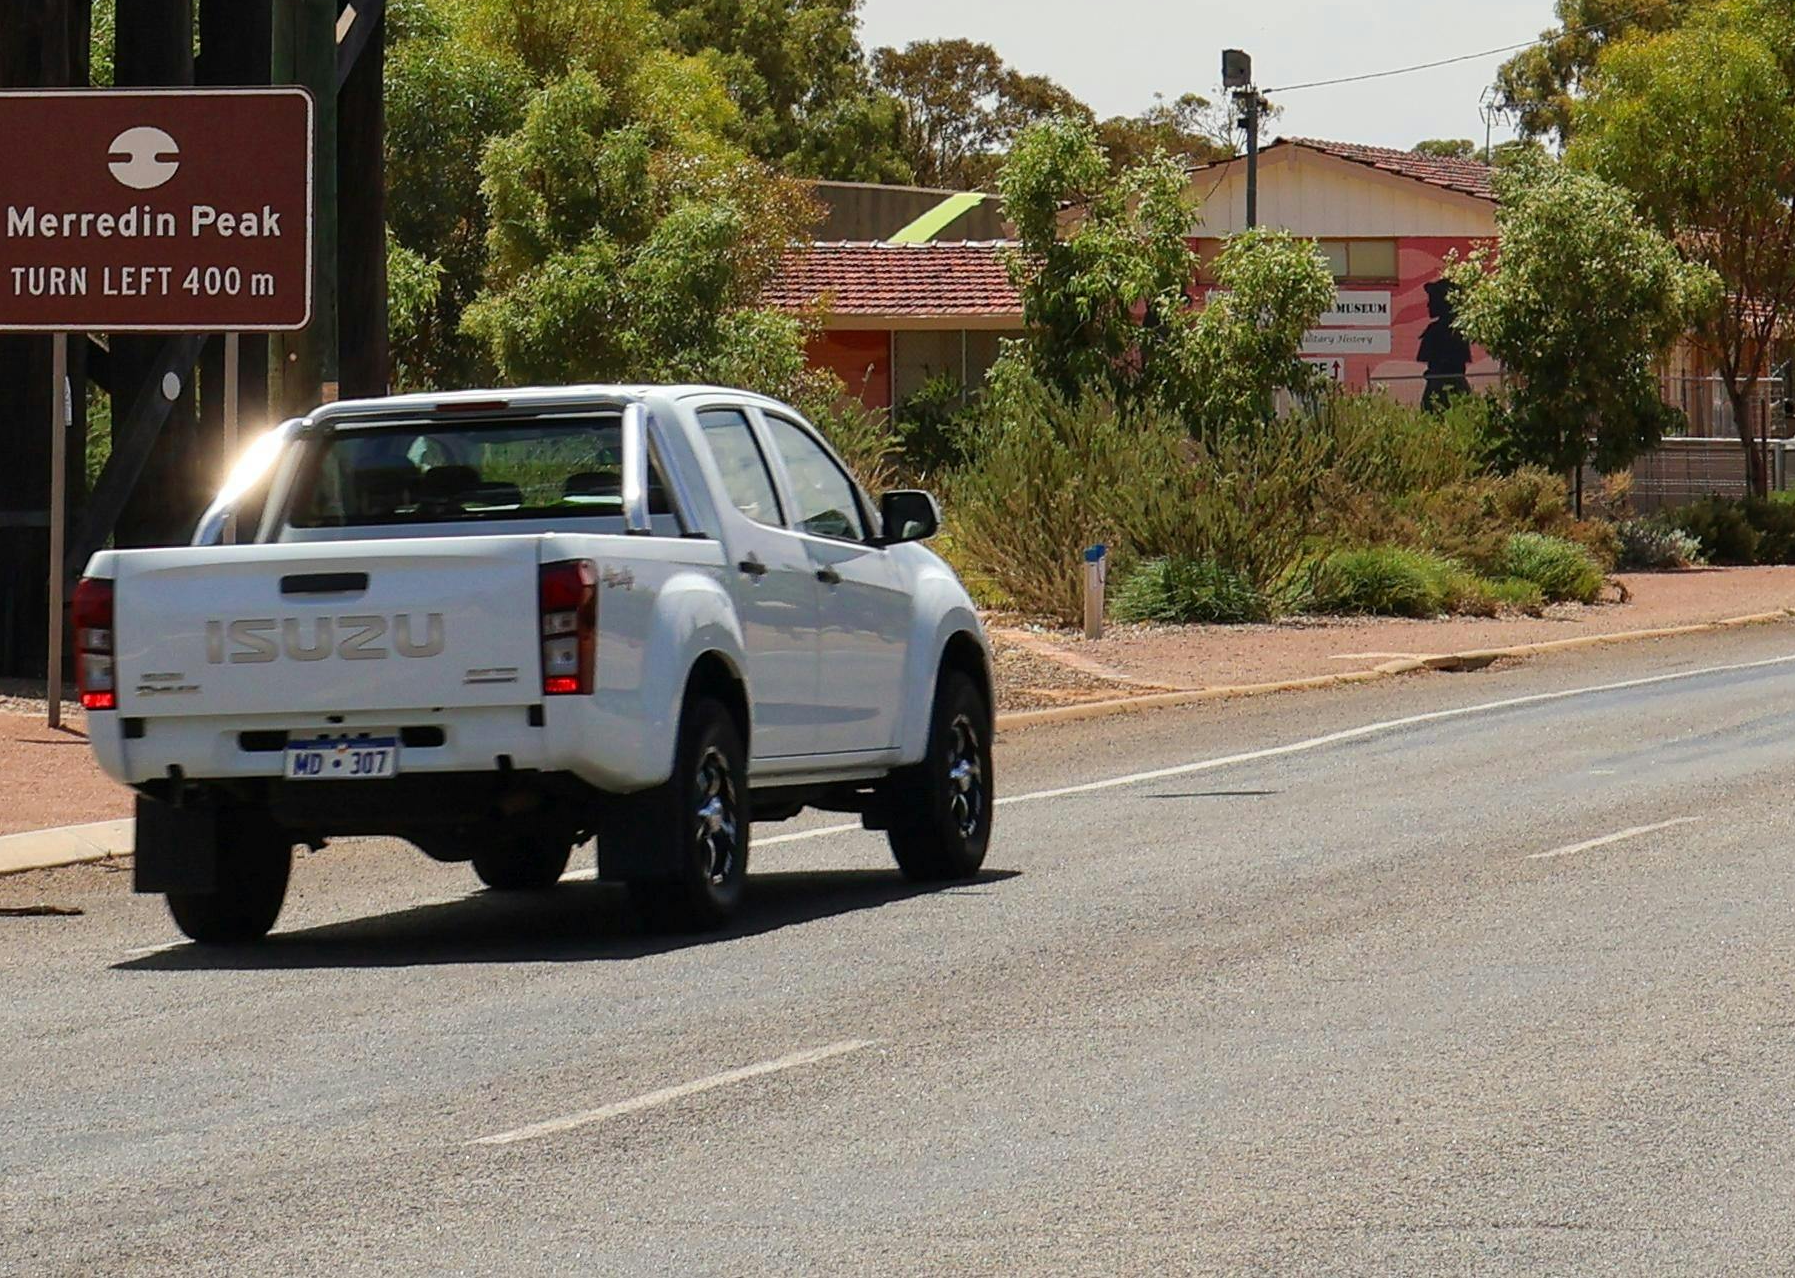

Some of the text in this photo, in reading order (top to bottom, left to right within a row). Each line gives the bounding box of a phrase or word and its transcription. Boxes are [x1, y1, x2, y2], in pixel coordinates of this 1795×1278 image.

[7, 205, 282, 237] Merredin Peak
[11, 267, 275, 296] TURN LEFT 400 m
[1336, 303, 1387, 314] MUSEUM
[1337, 334, 1373, 345] History
[205, 612, 446, 664] ISUZU
[292, 749, 388, 775] MD 307
